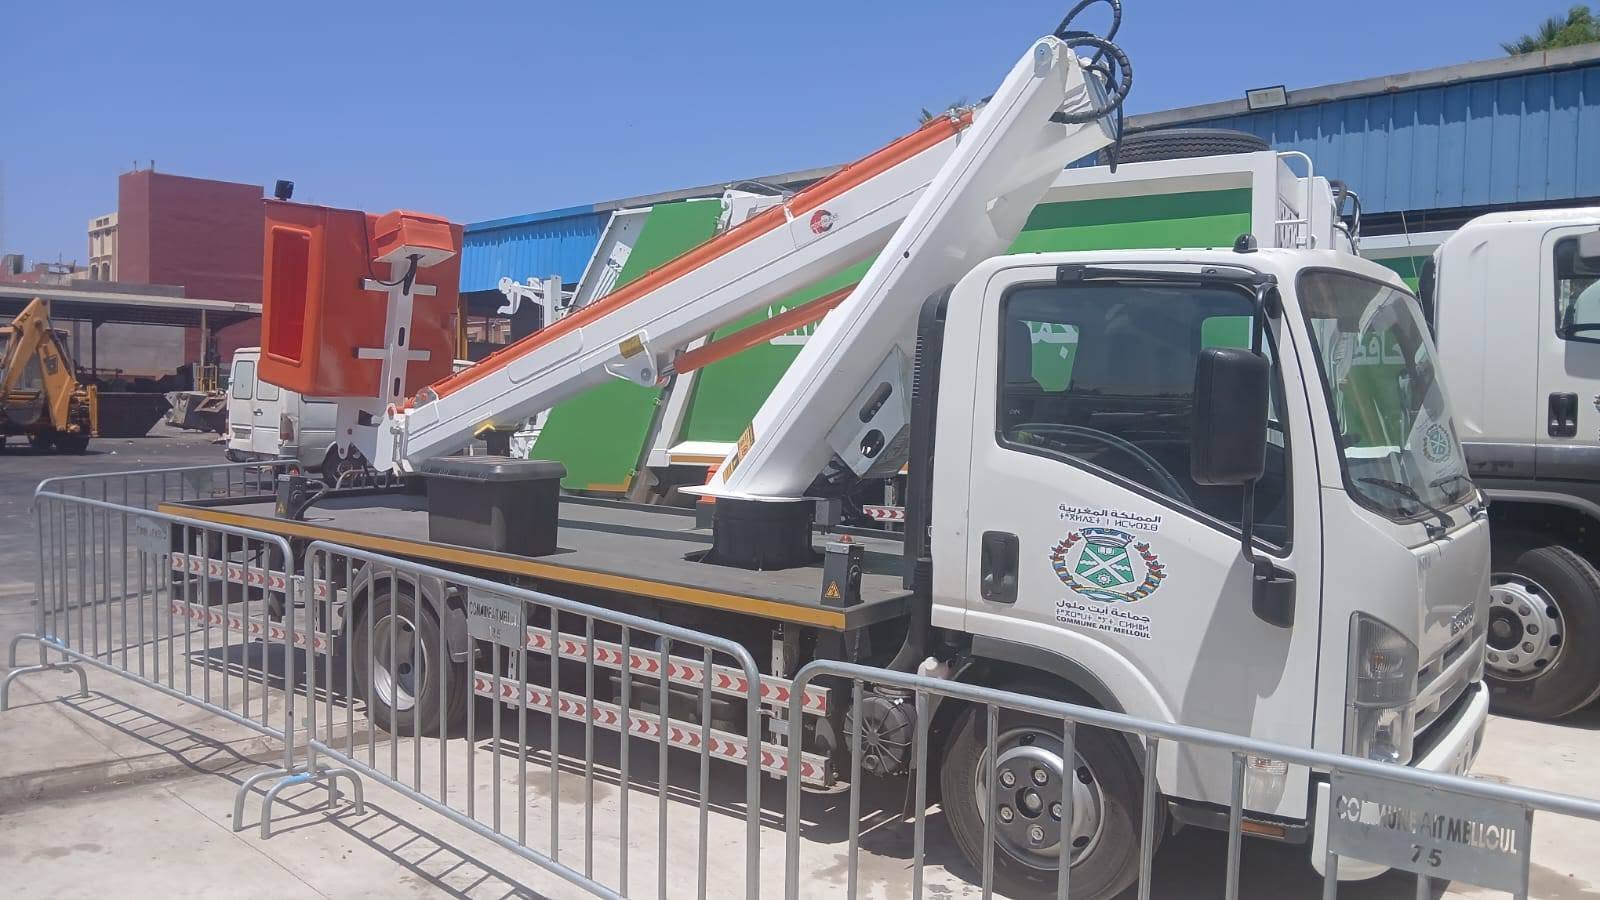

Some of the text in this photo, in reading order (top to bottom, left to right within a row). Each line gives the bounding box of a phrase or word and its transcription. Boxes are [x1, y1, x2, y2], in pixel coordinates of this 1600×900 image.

[1059, 503, 1161, 523] المملكة المغربية
[1056, 600, 1085, 610] ملول
[1110, 608, 1150, 623] جماعة
[1056, 615, 1151, 639] COMMUNE AIT MELLOUL
[1336, 795, 1517, 854] COMUNE AIT MELLOUL
[1411, 844, 1443, 867] 75
